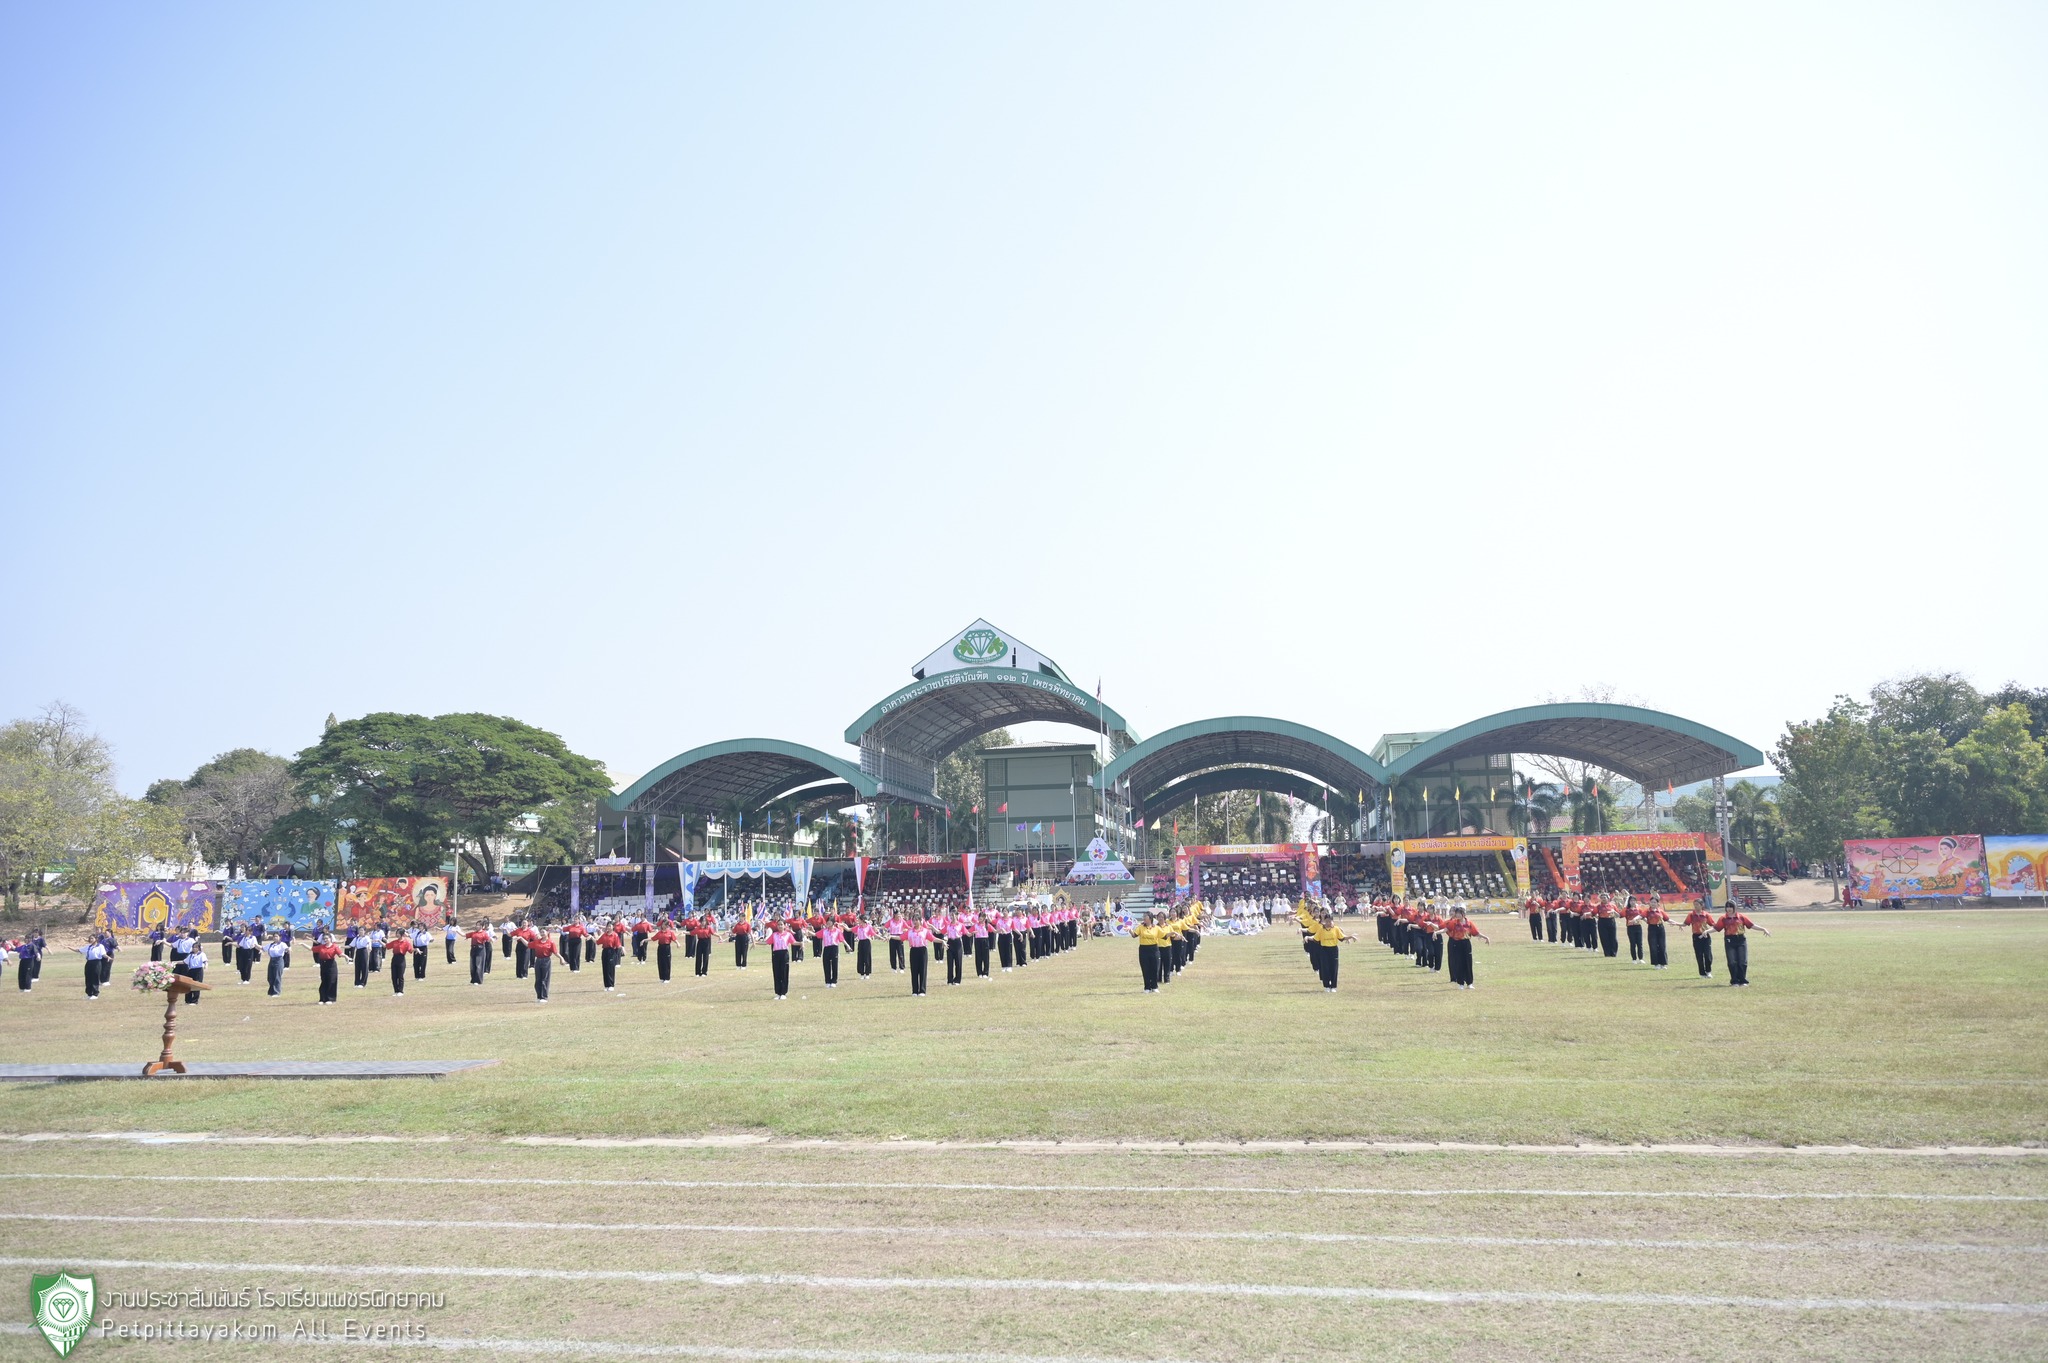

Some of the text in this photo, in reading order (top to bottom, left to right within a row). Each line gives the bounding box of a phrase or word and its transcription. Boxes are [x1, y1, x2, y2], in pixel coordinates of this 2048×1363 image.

[996, 674, 1017, 682] ๑๑๒
[1021, 672, 1029, 684] ปี
[1033, 678, 1087, 707] เพชรพิทยาคม
